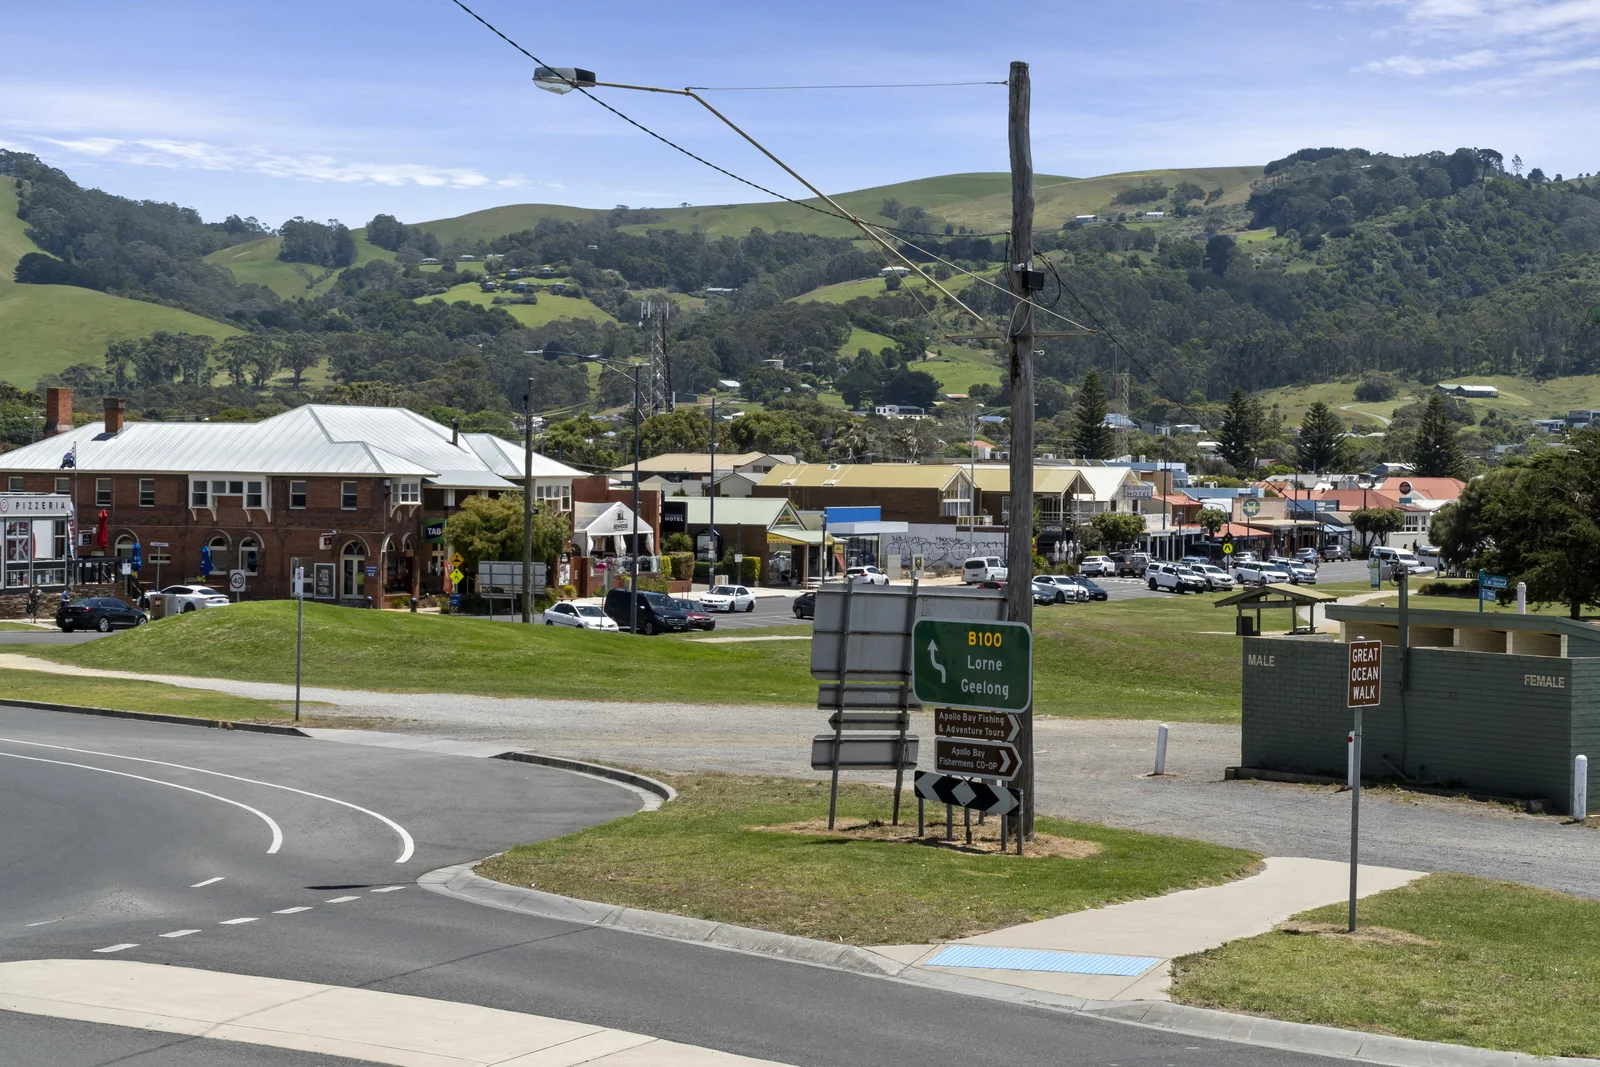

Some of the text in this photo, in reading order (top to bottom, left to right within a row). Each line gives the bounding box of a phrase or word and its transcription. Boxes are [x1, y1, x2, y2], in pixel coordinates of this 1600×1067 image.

[16, 501, 66, 510] PIZZERIA
[427, 527, 442, 535] TAB
[232, 577, 242, 585] 40
[968, 631, 1002, 647] B100
[1248, 654, 1275, 667] MALE
[1352, 648, 1379, 663] GREAT
[967, 655, 1002, 671] Lorne
[1351, 666, 1379, 681] OCEAN
[1524, 674, 1565, 689] FEMALE
[961, 678, 1009, 700] Geelong
[1353, 685, 1376, 700] WALK
[939, 712, 1005, 726] Apollo Bay Fishing
[938, 724, 1005, 737] & Adventure Tours
[951, 747, 986, 759] Apollo Bay
[939, 757, 998, 770] Fishermens CO-OP
